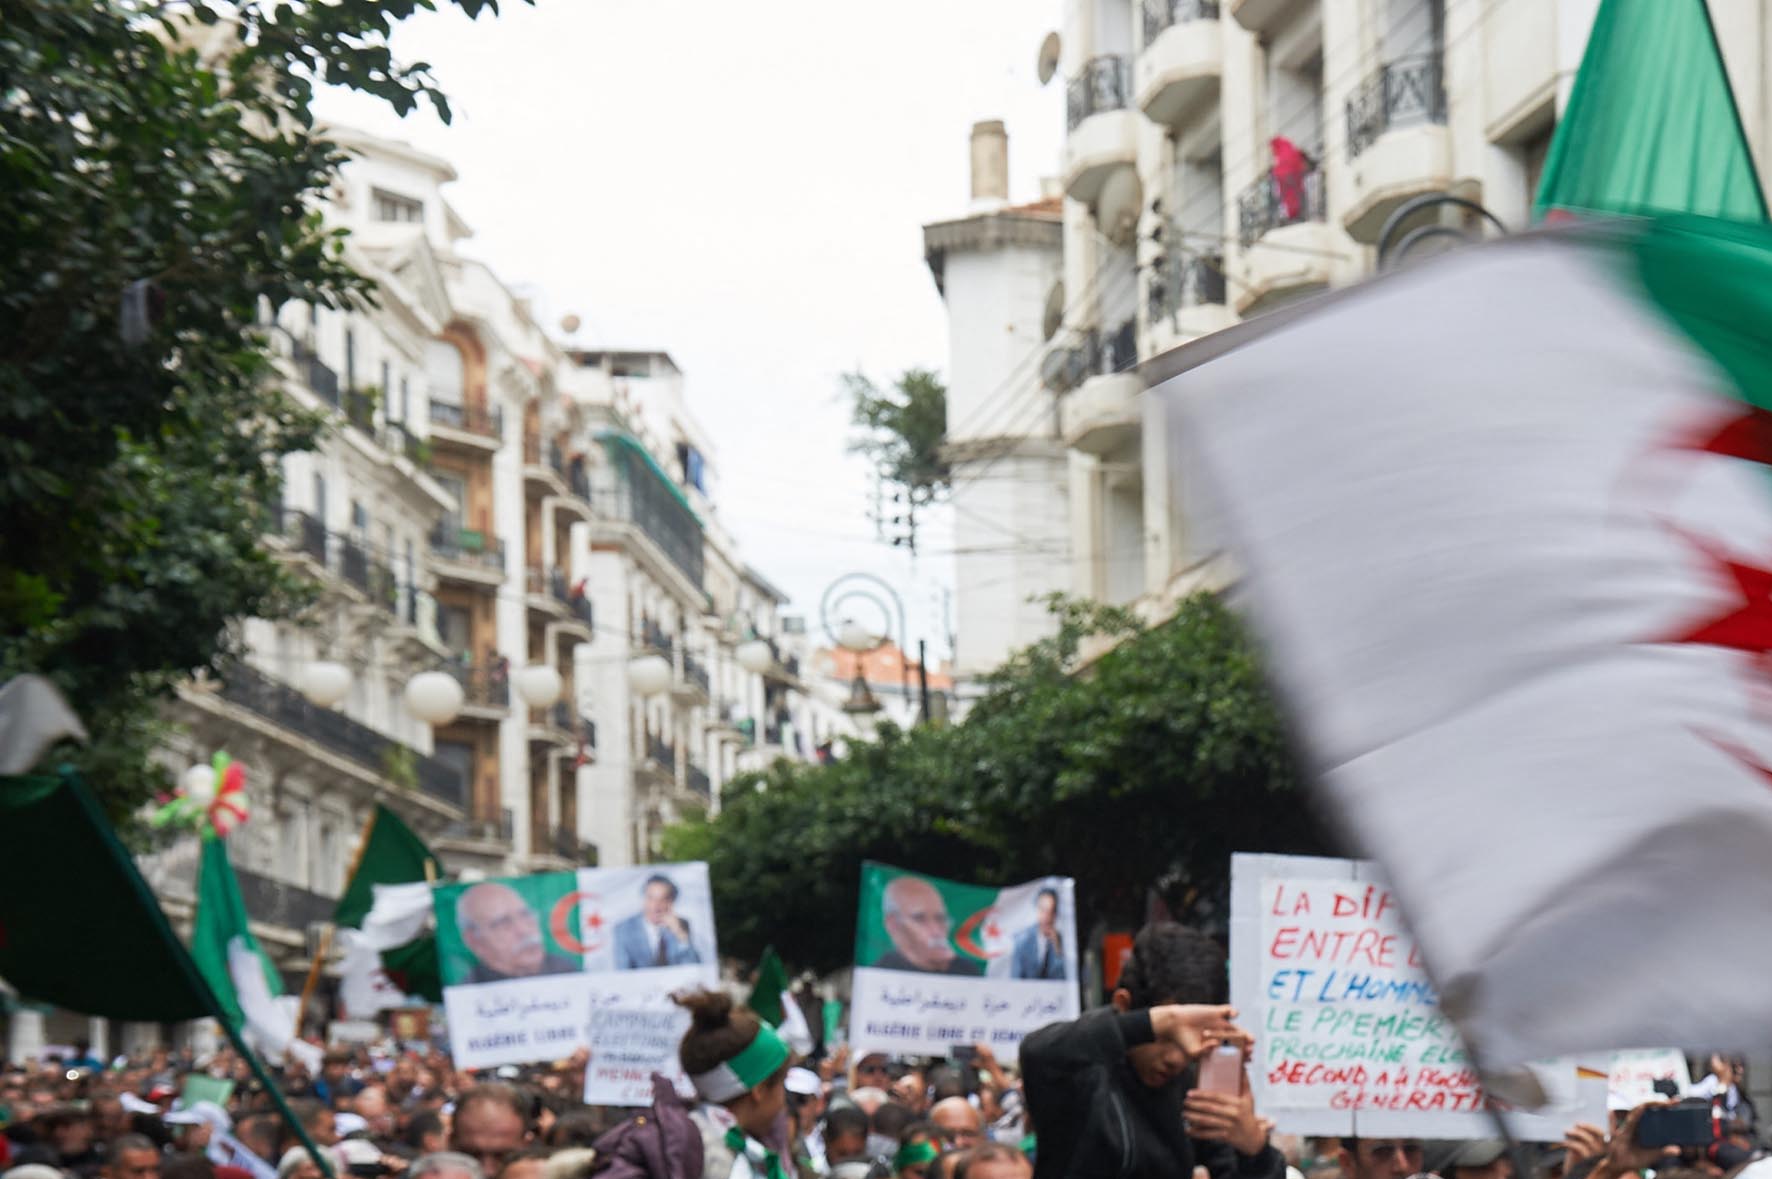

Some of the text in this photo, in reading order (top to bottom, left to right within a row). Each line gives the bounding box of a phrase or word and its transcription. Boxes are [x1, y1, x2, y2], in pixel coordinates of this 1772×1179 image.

[1271, 884, 1311, 917] LA
[1269, 928, 1399, 968] ENTRE
[1267, 969, 1315, 1002] ET
[1265, 1005, 1446, 1042] LE PREMIER
[1267, 1036, 1407, 1064] PROCHAINE
[1267, 1059, 1368, 1087] SECOND
